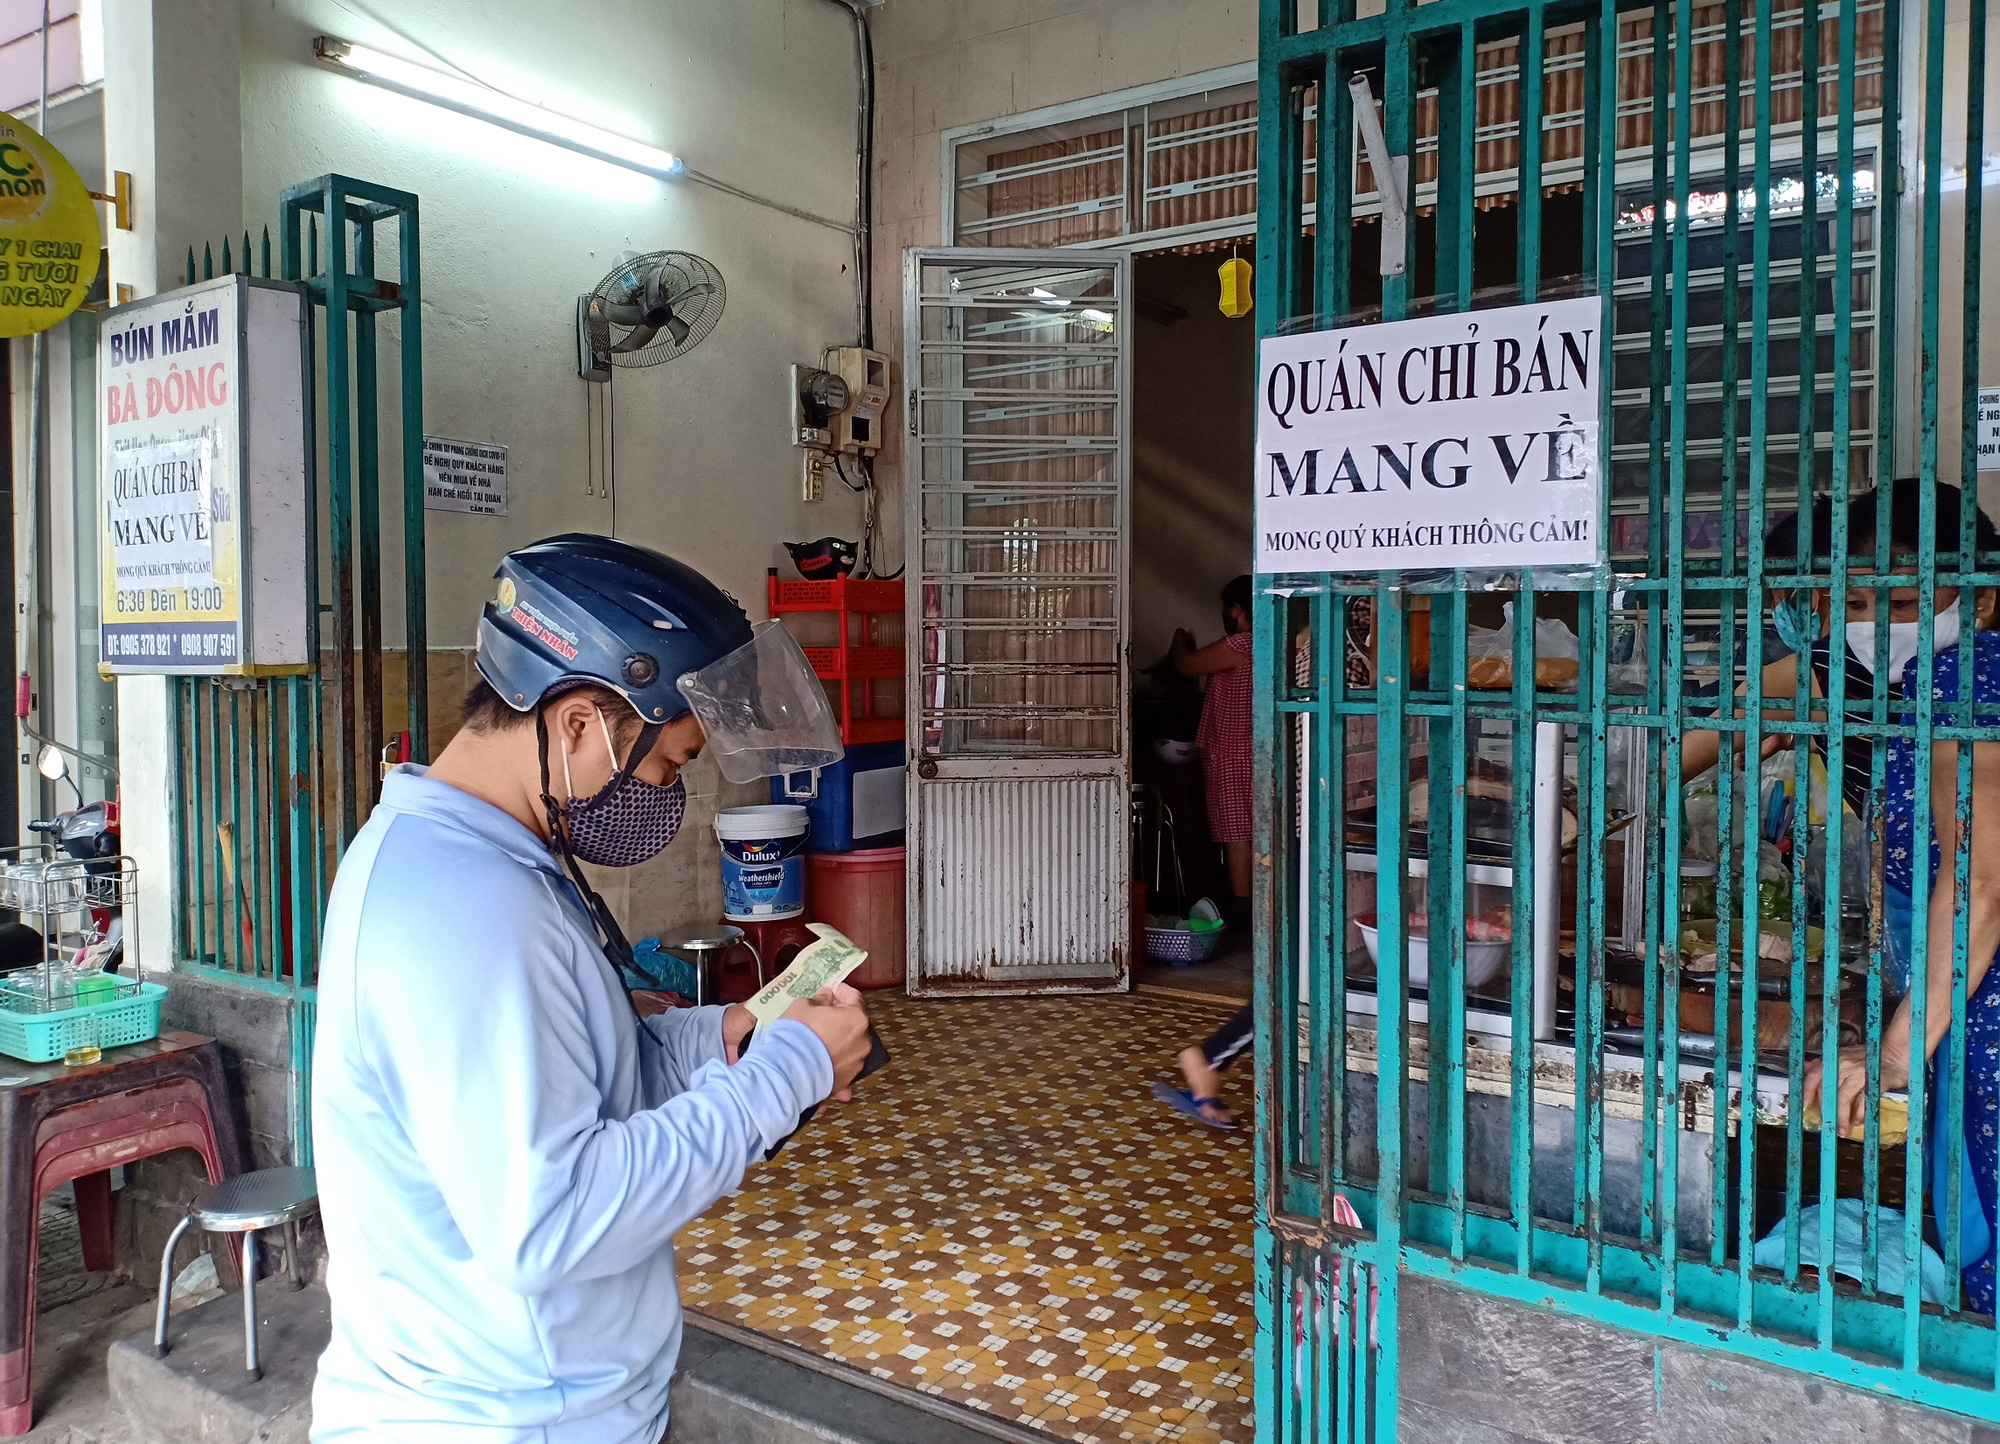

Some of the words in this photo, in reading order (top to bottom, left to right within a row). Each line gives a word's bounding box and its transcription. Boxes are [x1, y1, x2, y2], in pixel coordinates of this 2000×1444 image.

[16, 239, 27, 257] 1
[31, 240, 82, 260] CHAI
[17, 260, 79, 284] TƯƠI
[2, 284, 72, 308] NGÀY
[110, 322, 154, 368] BÚN
[161, 301, 220, 357] MẮM
[1266, 338, 1387, 430] QUÁN
[1397, 323, 1481, 406] CHỈ
[1491, 315, 1594, 398] BÁN
[107, 373, 140, 426] BÀ
[146, 362, 228, 419] ĐÔNG
[434, 457, 451, 471] NGHỊ
[452, 458, 465, 470] QUÝ
[465, 460, 487, 473] KHÁCH
[487, 463, 504, 475] HÀNG
[1265, 436, 1473, 499] MANG
[1487, 413, 1588, 486] VỀ
[114, 457, 150, 507] QUÁN
[152, 452, 176, 496] CHỈ
[438, 471, 452, 483] NÊN
[453, 474, 468, 485] MUA
[478, 476, 492, 488] NHÀ
[213, 487, 231, 524] Sữa
[428, 486, 442, 499] HẠN
[473, 492, 484, 504] TẠI
[484, 493, 501, 504] QUÁN
[114, 514, 176, 547] MANG
[178, 502, 208, 541] VỀ
[1265, 530, 1321, 552] MONG
[1325, 523, 1368, 554] QUÝ
[1371, 521, 1444, 548] KHÁCH
[1448, 517, 1524, 545] THÔNG
[1529, 514, 1589, 543] CẢM!
[116, 565, 135, 578] MONG
[148, 561, 171, 577] KHÁCH
[117, 590, 145, 613] 6:30
[183, 586, 222, 611] 19:00
[107, 634, 119, 656] ĐT:
[120, 634, 139, 656] 0905
[140, 634, 155, 656] 378
[156, 634, 171, 656] 921
[181, 634, 201, 656] 0908
[203, 634, 218, 657] 907
[220, 634, 236, 657] 591
[511, 606, 543, 636] THIỆN
[539, 629, 578, 660] NHÂN
[742, 851, 776, 862] Dulux
[738, 871, 785, 882] Weathershield
